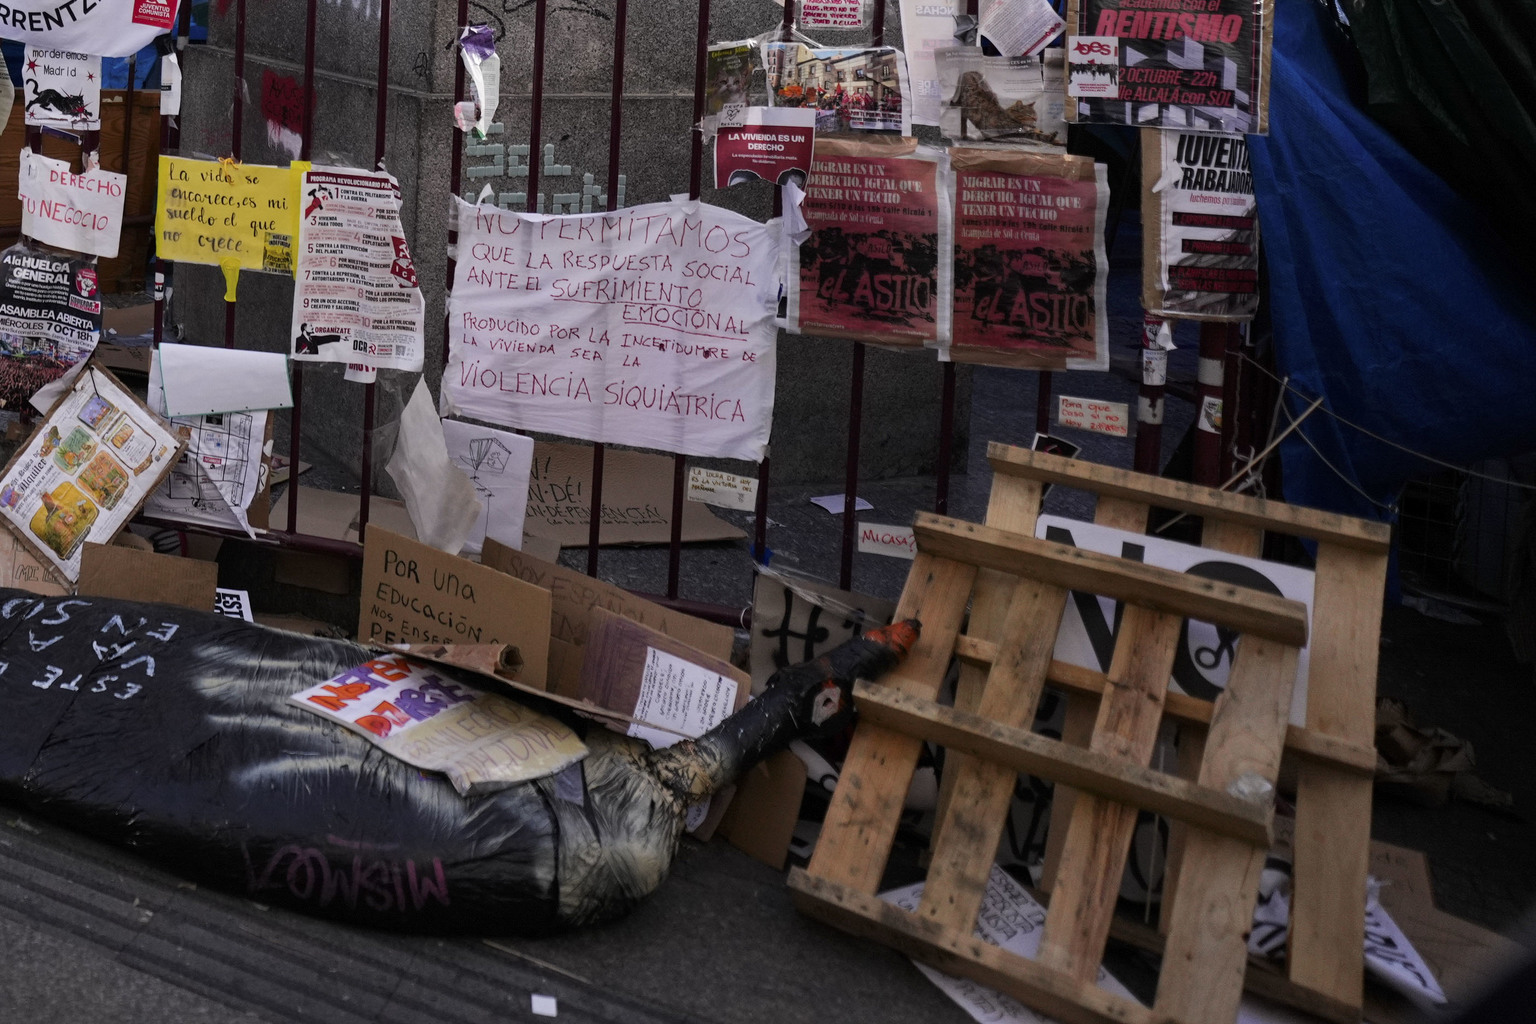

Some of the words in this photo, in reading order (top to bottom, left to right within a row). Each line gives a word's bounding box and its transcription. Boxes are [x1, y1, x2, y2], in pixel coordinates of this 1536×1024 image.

[138, 8, 170, 18] COMUNISTA
[139, 3, 170, 12] JUVENTUD
[1094, 10, 1243, 44] RENTISMO
[32, 48, 88, 61] morderemos
[43, 64, 77, 77] Madrid
[1127, 68, 1181, 86] OCTUBRE
[1192, 71, 1217, 87] 22h
[1134, 86, 1179, 103] ALCALÁ
[1181, 92, 1205, 104] con
[1208, 91, 1233, 107] SOL
[741, 134, 777, 142] VIVIENDA
[778, 134, 790, 142] ES
[792, 135, 804, 143] UN
[748, 143, 784, 152] DERECHO
[169, 163, 190, 182] La
[200, 168, 235, 184] vida
[245, 175, 260, 184] se
[853, 164, 866, 174] ES
[868, 164, 885, 176] UN
[50, 170, 122, 197] DERECHO
[337, 178, 380, 187] REVOLUCIONARIO
[864, 176, 897, 190] IGUAL
[899, 180, 922, 194] QUE
[962, 176, 1009, 191] MIGRAR
[1011, 178, 1025, 192] ES
[1027, 178, 1041, 192] UN
[268, 198, 288, 210] mi
[807, 186, 843, 201] TENER
[845, 189, 861, 202] UN
[863, 190, 901, 204] TECHO
[1019, 190, 1053, 207] IGUAL
[1056, 194, 1082, 210] QUE
[20, 193, 36, 214] TU
[39, 199, 108, 231] NEGOCIO
[961, 203, 998, 218] TENER
[999, 206, 1017, 219] UN
[1019, 207, 1058, 222] TECHO
[166, 208, 217, 226] sueldo
[223, 212, 237, 227] el
[250, 219, 276, 237] que
[163, 231, 180, 242] no
[22, 257, 70, 273] HUELGA
[472, 243, 515, 264] QUE
[526, 254, 552, 270] LA
[563, 250, 673, 272] RESPUESTA
[13, 268, 70, 285] GENERAL
[467, 267, 519, 291] ANTE
[526, 276, 542, 291] EL
[0, 304, 55, 320] ASAMBLEA
[56, 312, 93, 330] ABIERTA
[46, 322, 53, 330] 7
[54, 324, 76, 337] OCT
[315, 326, 351, 334] ORGANÍZATE
[353, 339, 367, 351] OCR
[463, 335, 478, 347] LA
[570, 348, 603, 361] SEA
[623, 354, 641, 367] LA
[550, 325, 580, 340] POR
[589, 328, 610, 345] LA
[742, 351, 756, 363] DE
[20, 458, 46, 493] Alquiler
[384, 550, 420, 584] POR
[434, 568, 476, 603] una
[371, 604, 394, 622] NOS
[29, 629, 64, 652] A
[31, 664, 143, 700] ESTE
